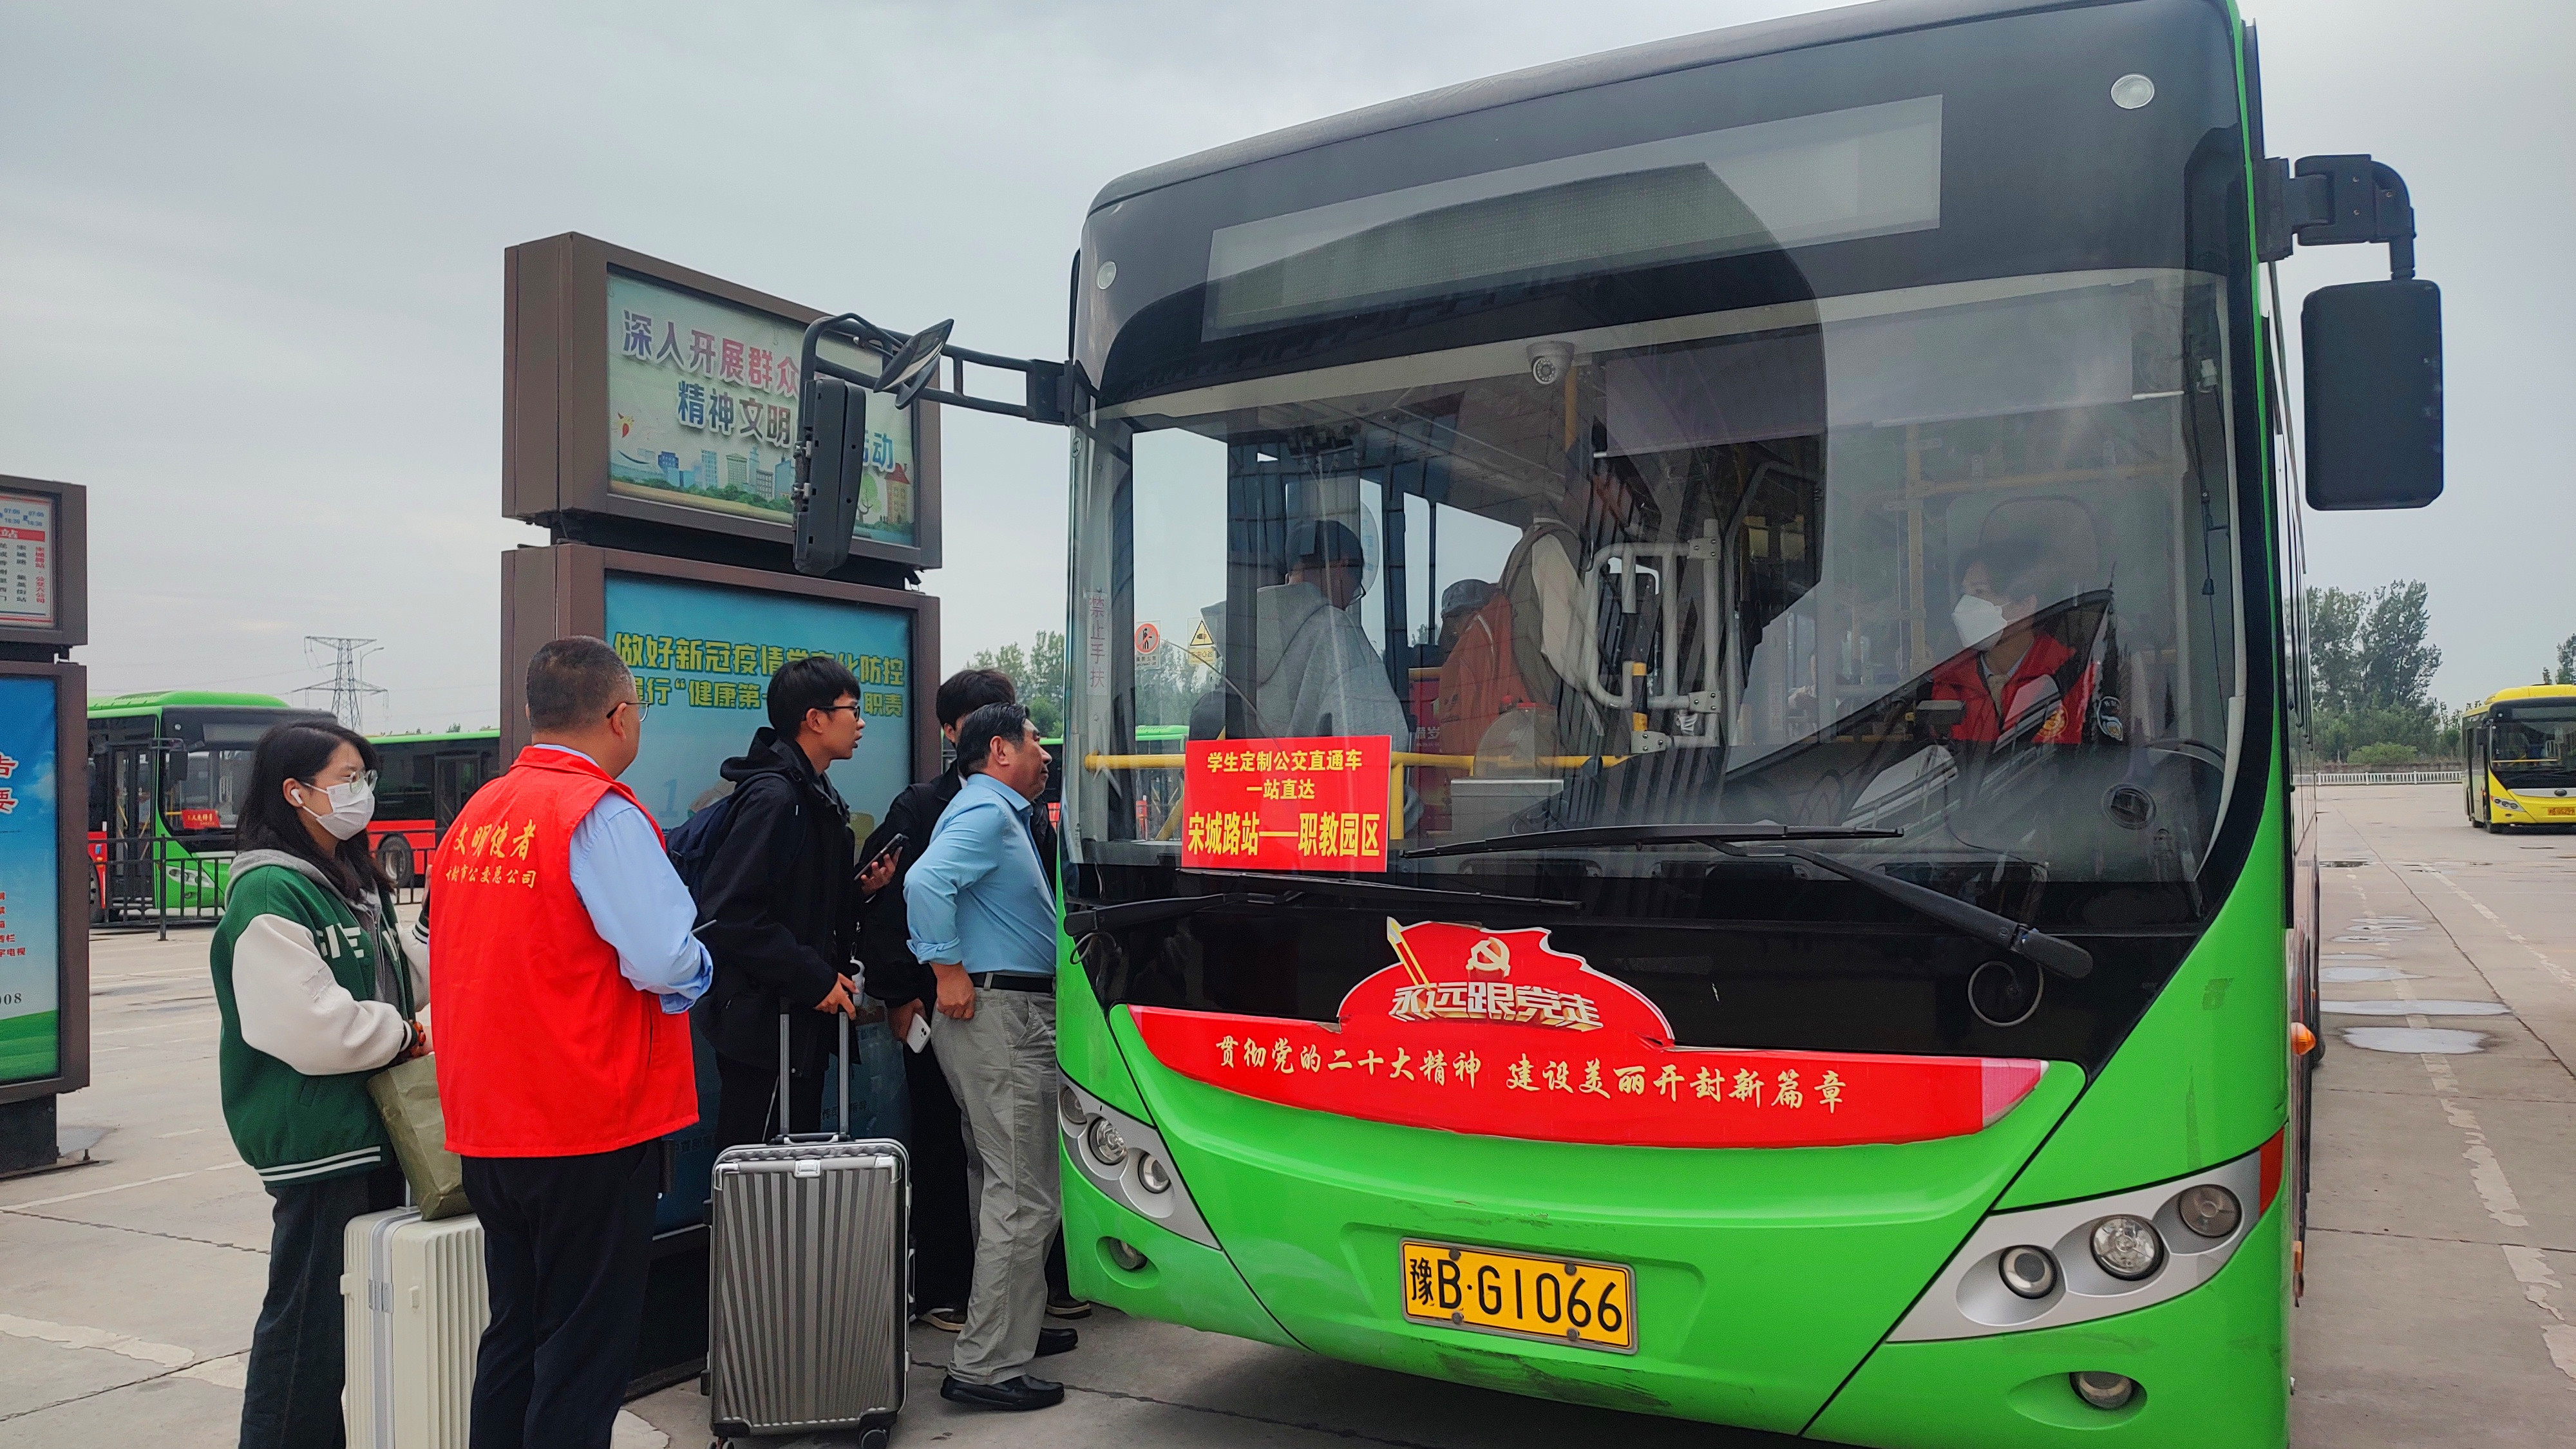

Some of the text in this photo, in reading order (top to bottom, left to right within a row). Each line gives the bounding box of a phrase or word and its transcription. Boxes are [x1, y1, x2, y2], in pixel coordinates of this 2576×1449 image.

[1088, 595, 1106, 688] 禁止手扶
[1207, 748, 1363, 773] 学生定制公交直通车
[1246, 778, 1316, 800] 一站直达
[0, 992, 23, 1005] 08
[1388, 981, 1604, 1032] 永远跟党走
[1215, 1035, 1847, 1114] 贯彻党的二十大精神 建设美丽开封新篇章
